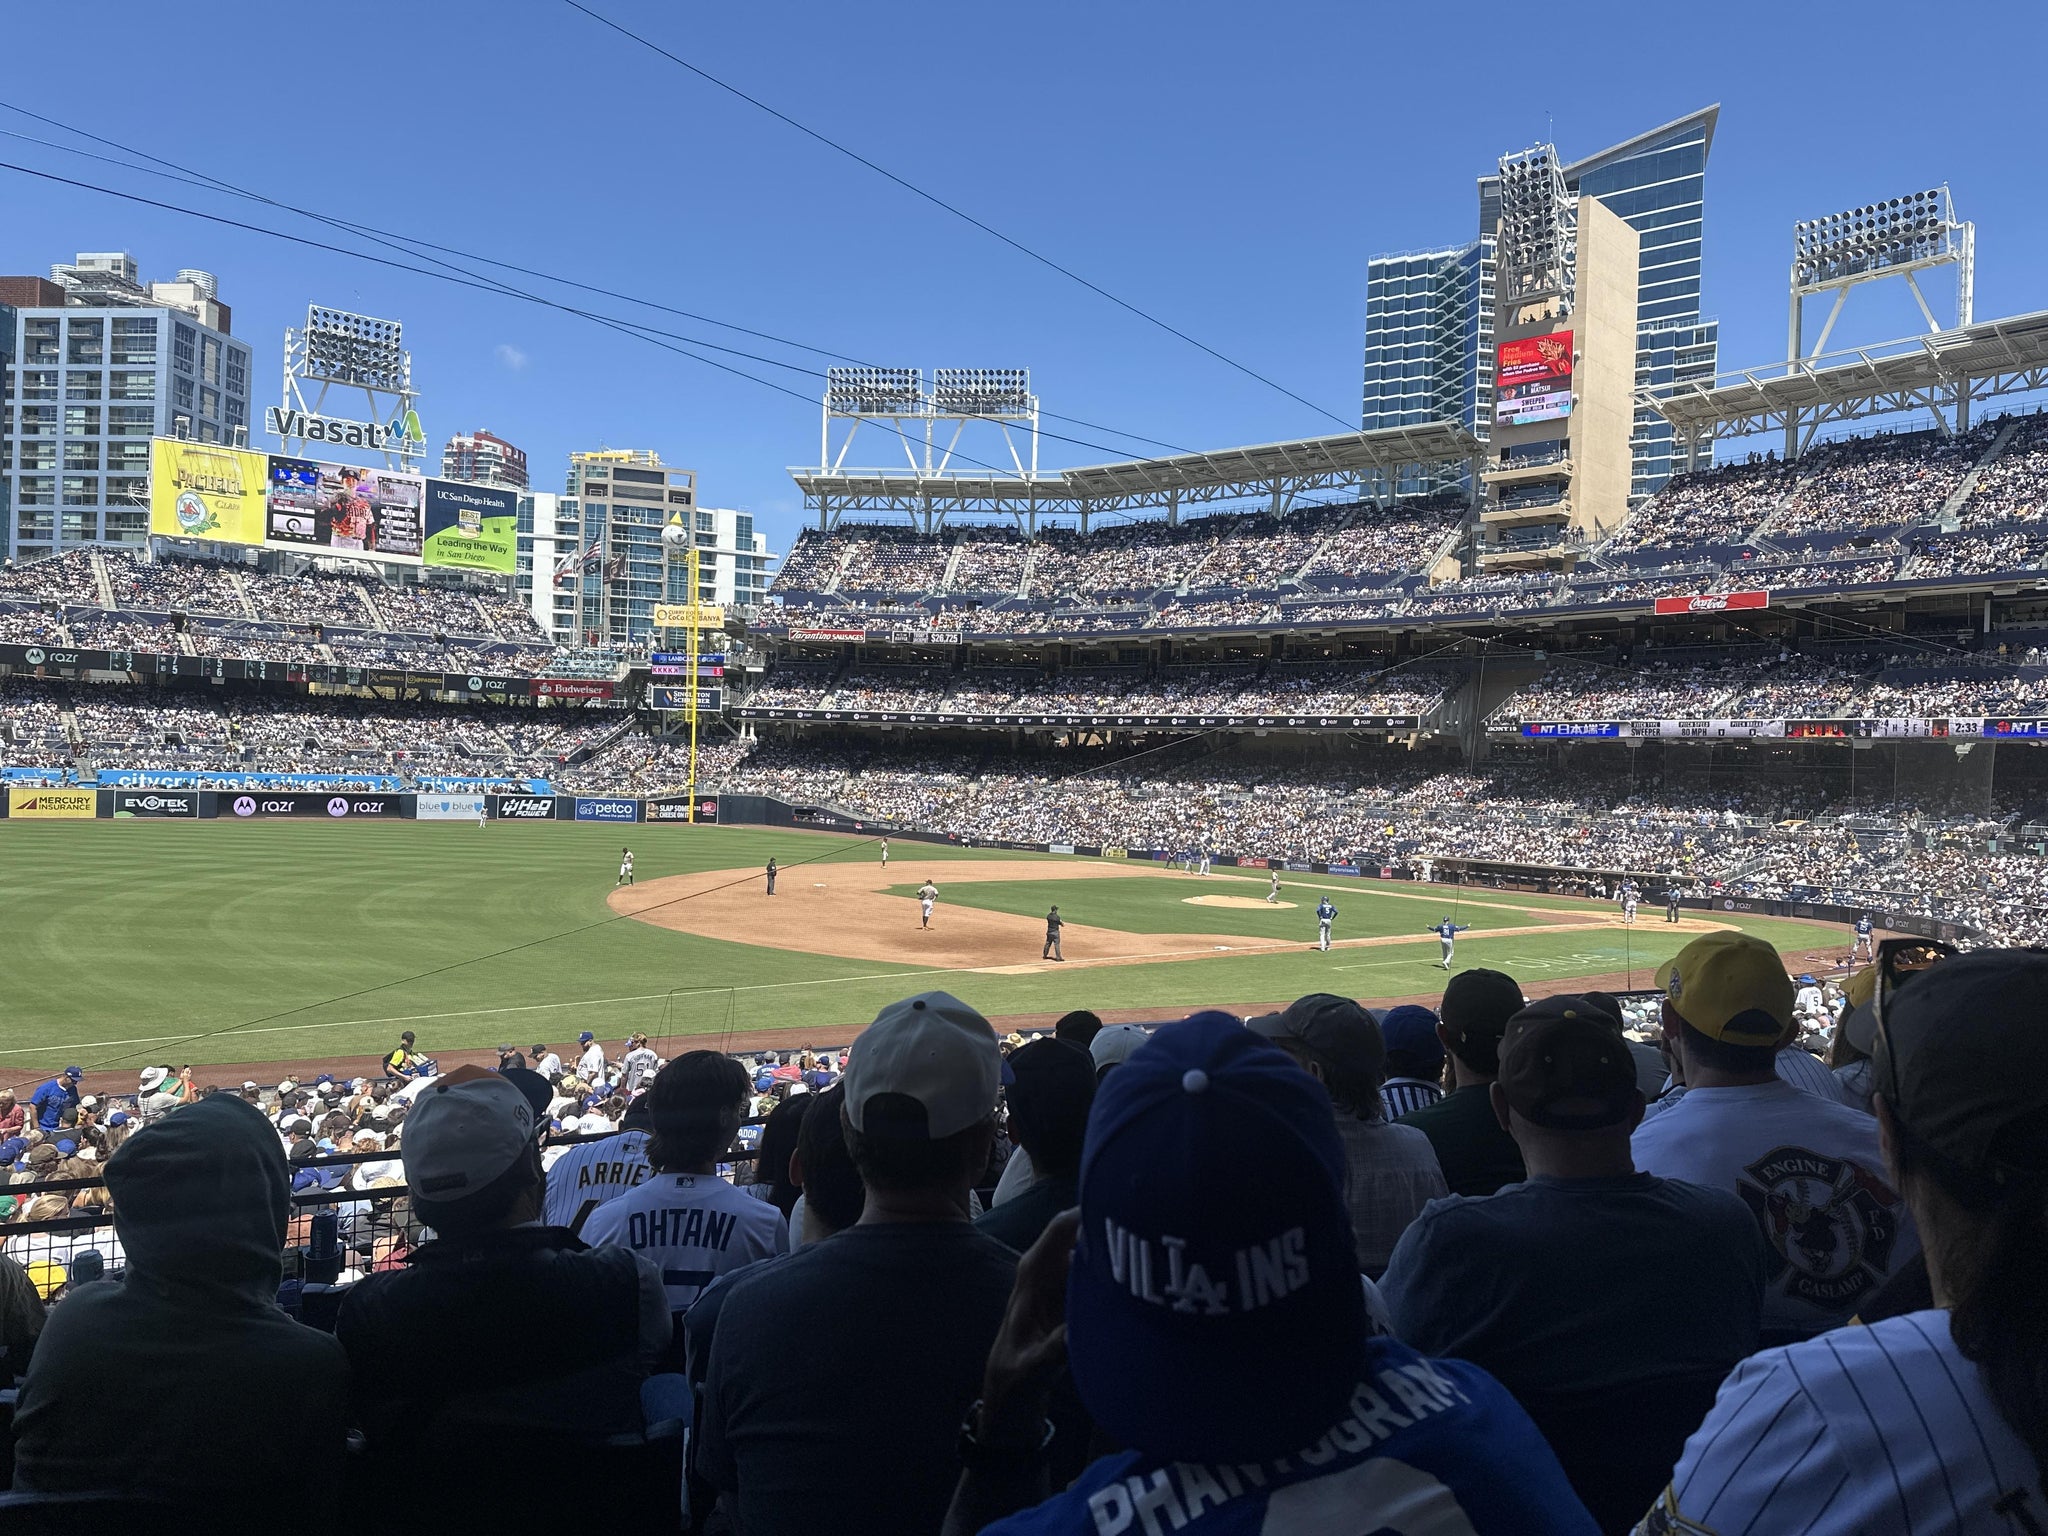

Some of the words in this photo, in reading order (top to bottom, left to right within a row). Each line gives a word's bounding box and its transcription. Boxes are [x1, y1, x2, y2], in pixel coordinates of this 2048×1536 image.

[1522, 385, 1526, 394] 1
[1531, 385, 1550, 394] MATSUI
[1521, 397, 1545, 406] SWEEPER
[272, 407, 380, 449] Viasat
[437, 490, 448, 499] UC
[449, 492, 462, 501] San
[463, 494, 482, 505] Diego
[483, 498, 505, 508] Health
[461, 511, 479, 519] BEST
[437, 538, 472, 550] Leading
[474, 542, 487, 551] the
[489, 544, 507, 554] Way
[437, 549, 444, 557] in
[447, 550, 462, 558] San
[465, 553, 485, 562] Diego
[790, 631, 832, 640] Tarantino
[832, 633, 864, 641] SAUSAGES
[931, 633, 958, 643] $26,725
[50, 653, 78, 663] razr
[126, 653, 132, 661] 3
[173, 656, 178, 664] 7
[126, 662, 132, 672] 2
[217, 659, 223, 668] 5
[260, 662, 265, 670] 5
[172, 665, 178, 674] 5
[217, 668, 223, 677] 6
[259, 671, 265, 680] 4
[302, 673, 306, 681] 4
[486, 680, 507, 689] razr
[555, 684, 603, 694] Budweiser
[1540, 725, 1555, 733] NT
[1557, 724, 1611, 734] 日本端子
[1904, 728, 1908, 736] 2
[1924, 728, 1929, 736] 0
[1955, 723, 1977, 733] 2:33
[2011, 722, 2032, 733] NT
[125, 796, 188, 810] EVOTEK
[261, 801, 294, 812] razr
[354, 802, 384, 813] razr
[419, 802, 440, 810] blue
[452, 802, 474, 810] blue
[596, 802, 632, 815] petco
[1736, 902, 1751, 910] razr
[1895, 920, 1909, 928] razr
[1813, 996, 1819, 1007] 5
[737, 1129, 757, 1139] ADOR
[1762, 1159, 1829, 1180] ENGINE
[629, 1206, 737, 1251] OHTANI
